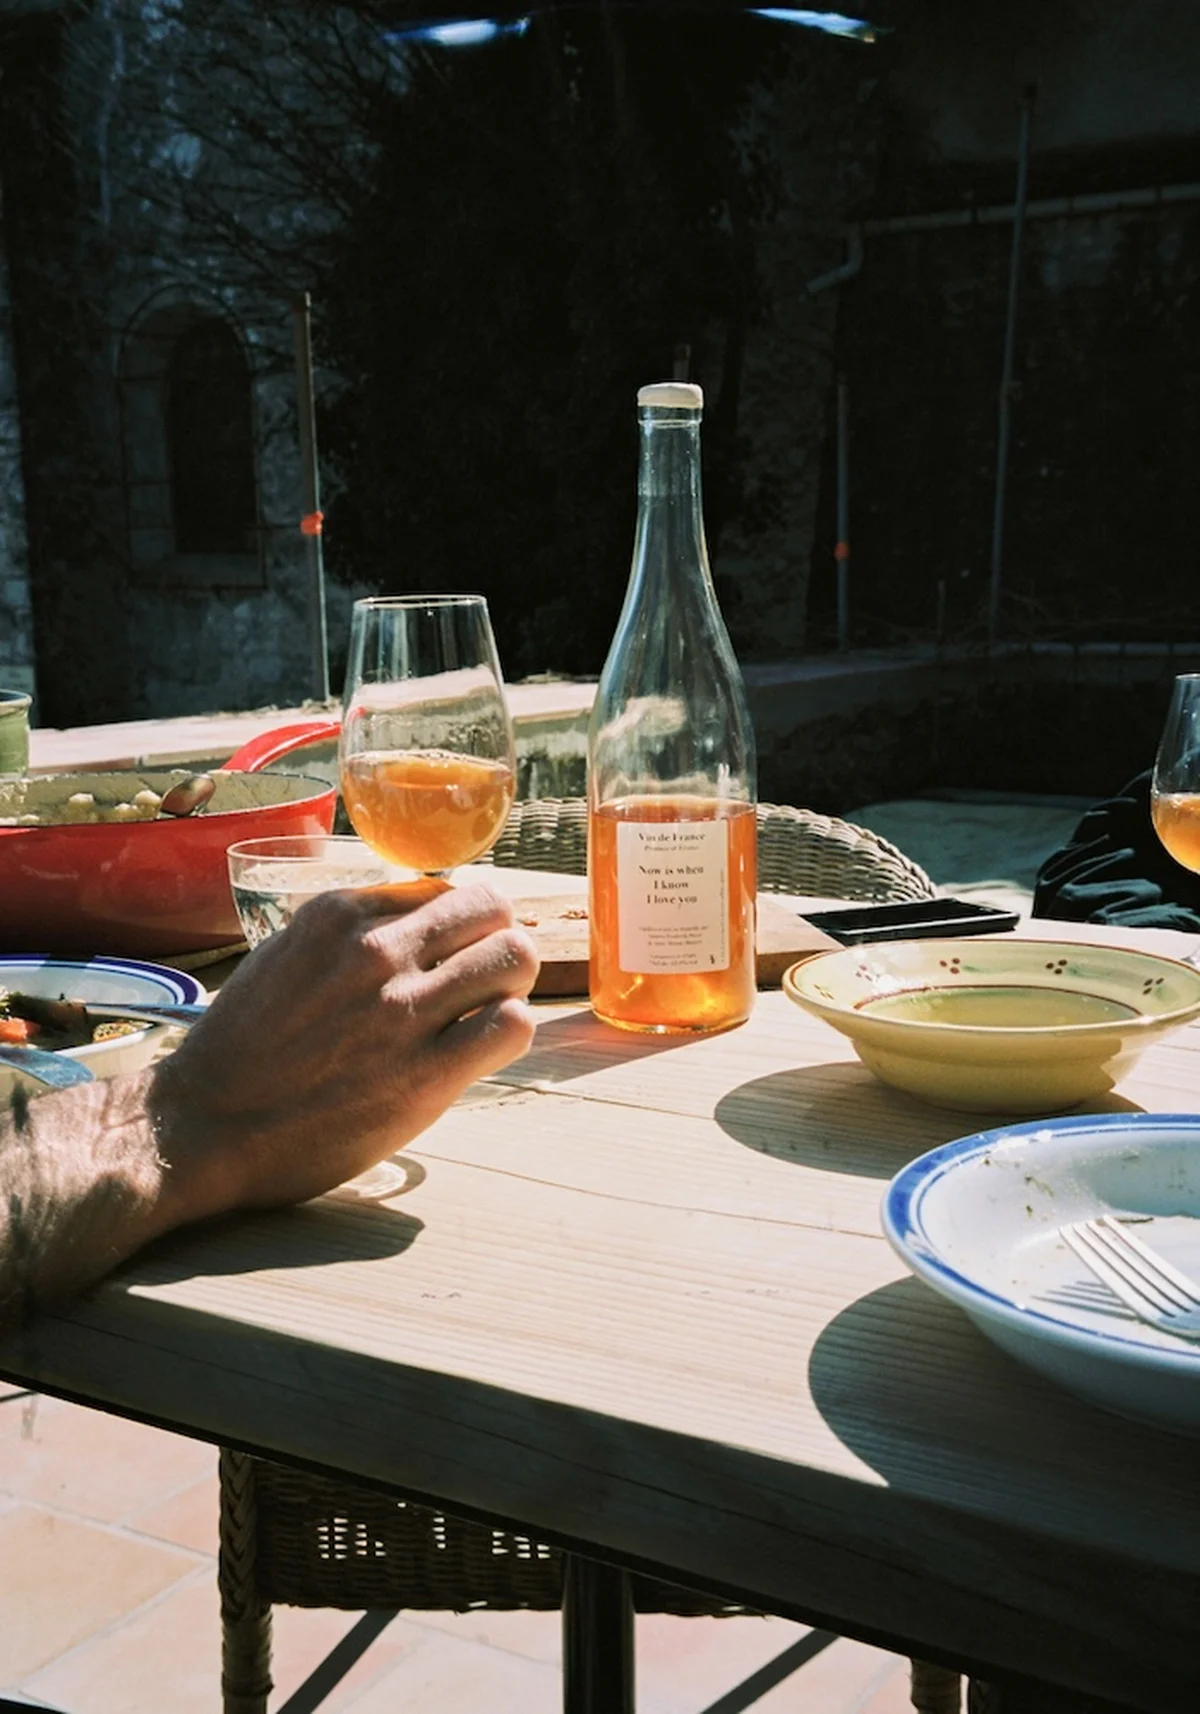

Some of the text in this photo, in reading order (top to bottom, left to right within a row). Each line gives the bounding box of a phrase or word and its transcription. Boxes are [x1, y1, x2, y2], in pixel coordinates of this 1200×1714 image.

[638, 832, 706, 841] Vin de France
[639, 865, 704, 875] Now is when
[654, 880, 689, 889] I know
[647, 894, 698, 910] I love you
